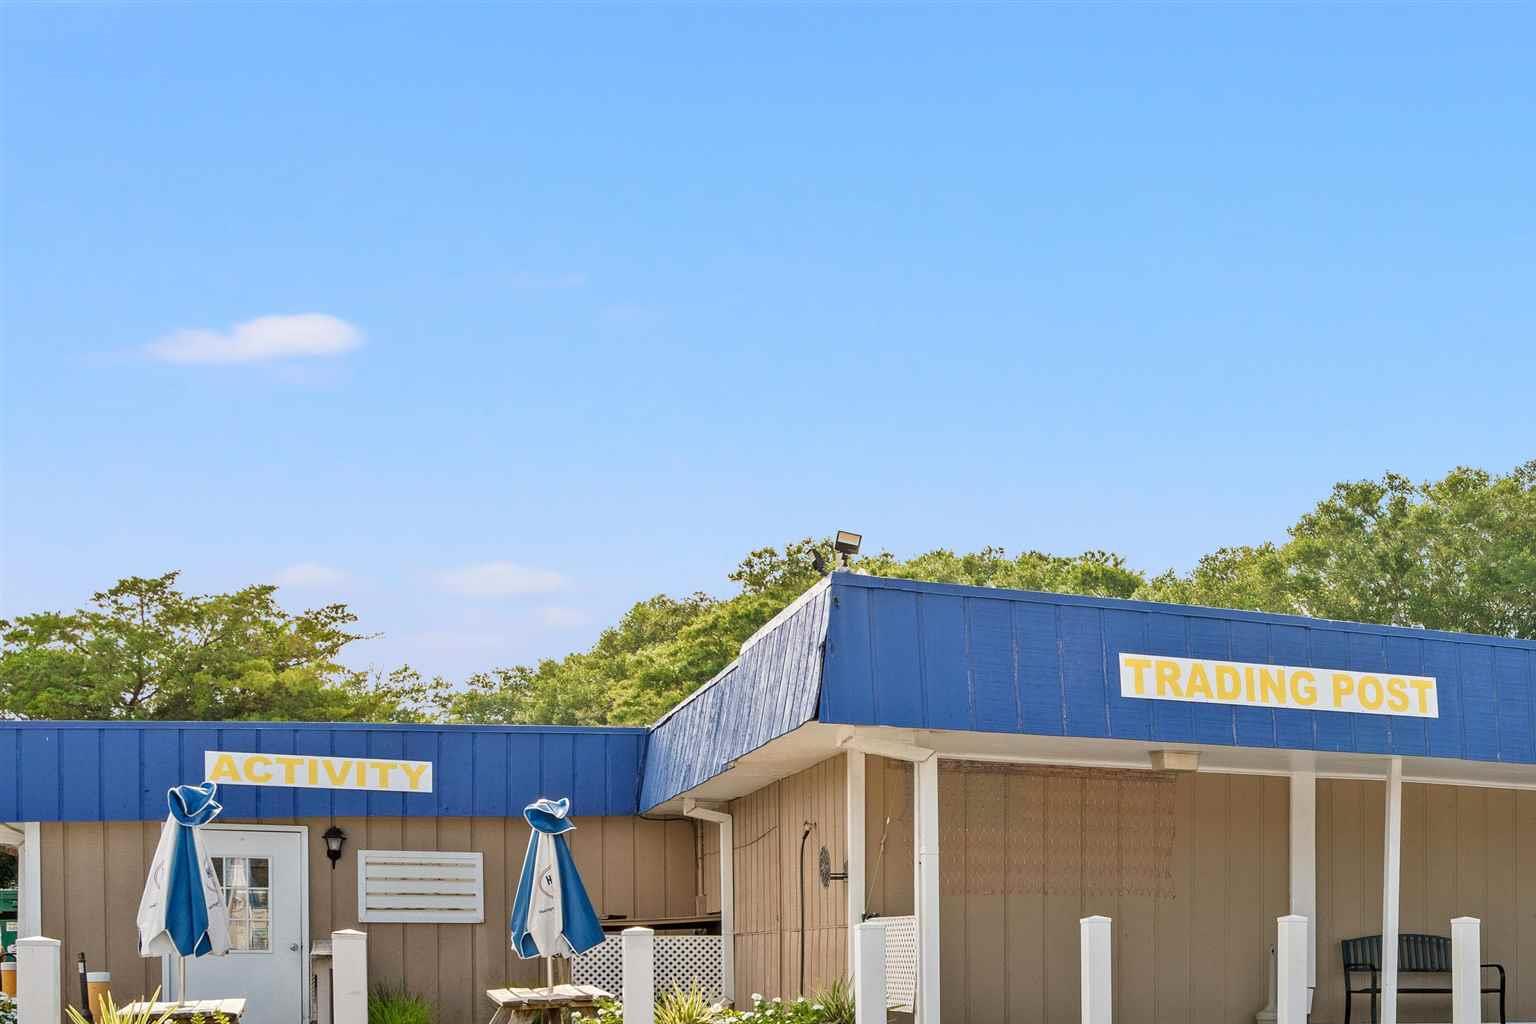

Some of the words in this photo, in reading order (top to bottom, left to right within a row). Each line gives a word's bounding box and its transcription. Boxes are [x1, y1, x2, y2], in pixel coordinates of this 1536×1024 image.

[1124, 658, 1318, 706] TRADING
[1332, 674, 1434, 713] POST
[208, 753, 430, 790] ACTIVITY
